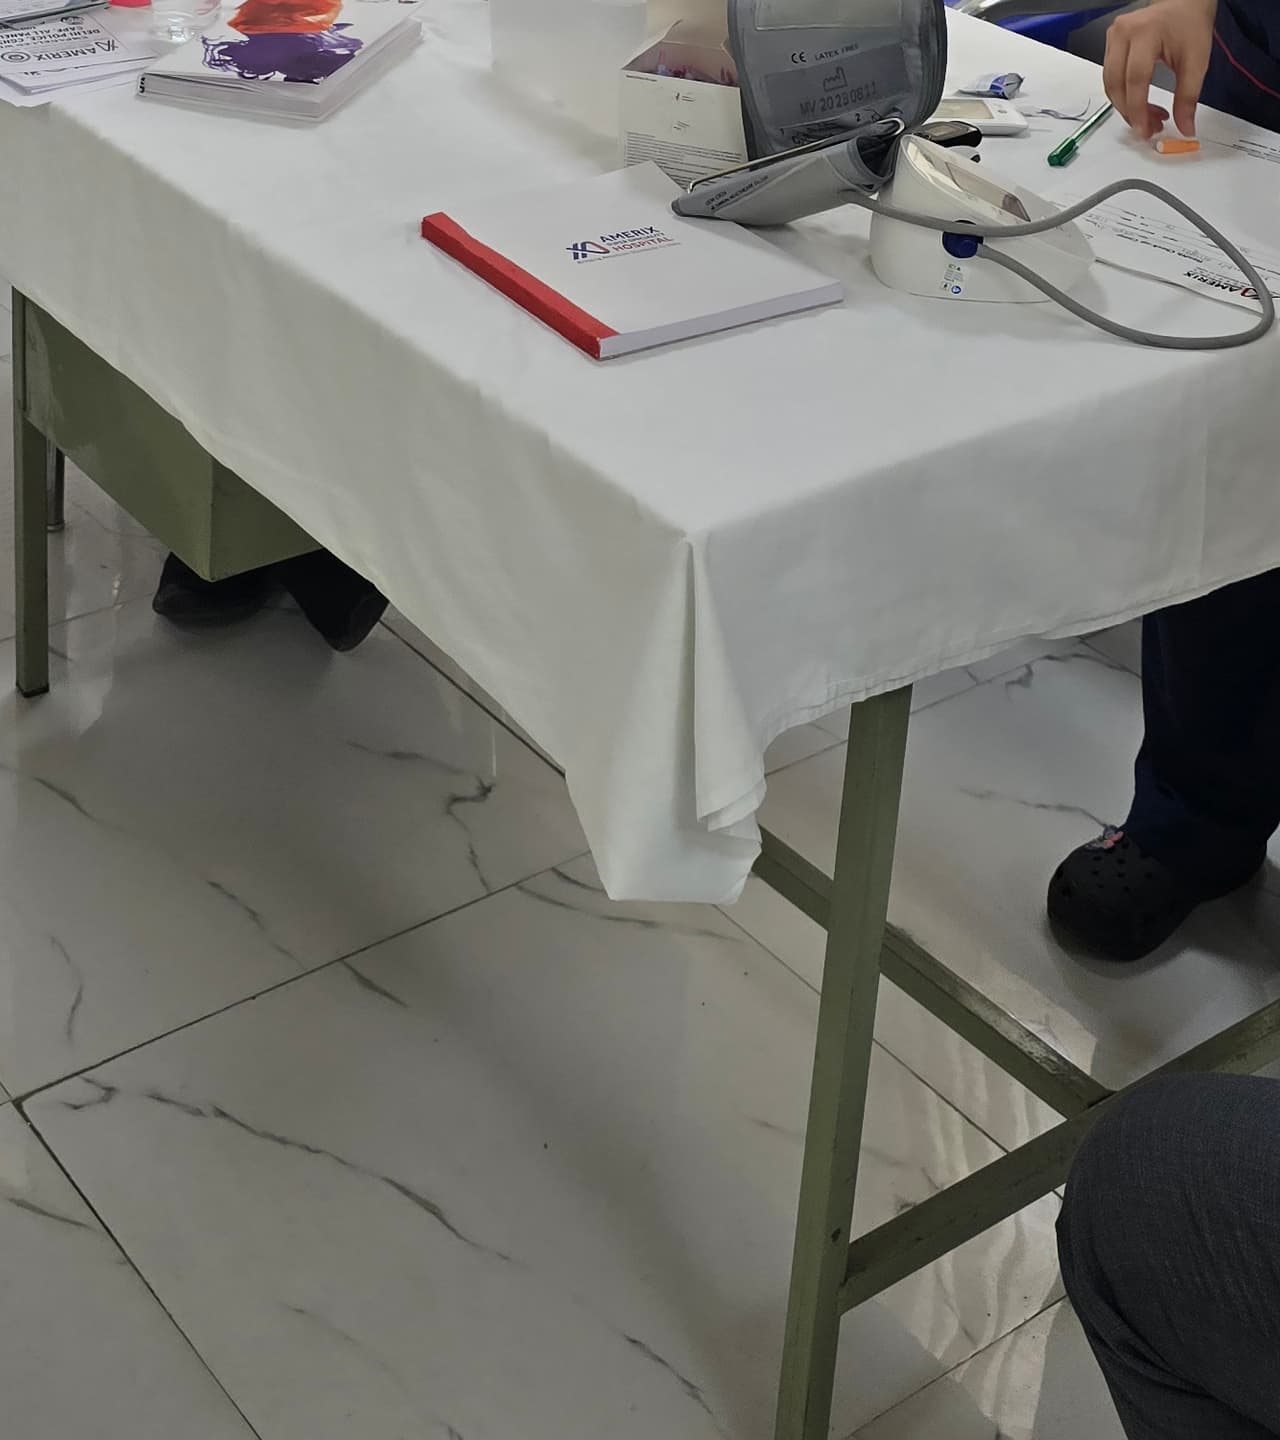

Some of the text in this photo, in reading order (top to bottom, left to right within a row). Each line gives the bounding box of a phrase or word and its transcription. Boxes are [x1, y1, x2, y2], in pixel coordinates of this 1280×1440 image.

[0, 32, 31, 40] PANEL
[69, 28, 100, 37] DELHI
[32, 47, 97, 62] AMERIX
[815, 51, 839, 60] LATEX
[600, 226, 659, 243] AMERIX
[612, 237, 673, 252] HOSPITAL
[1184, 271, 1242, 293] AMERIX
